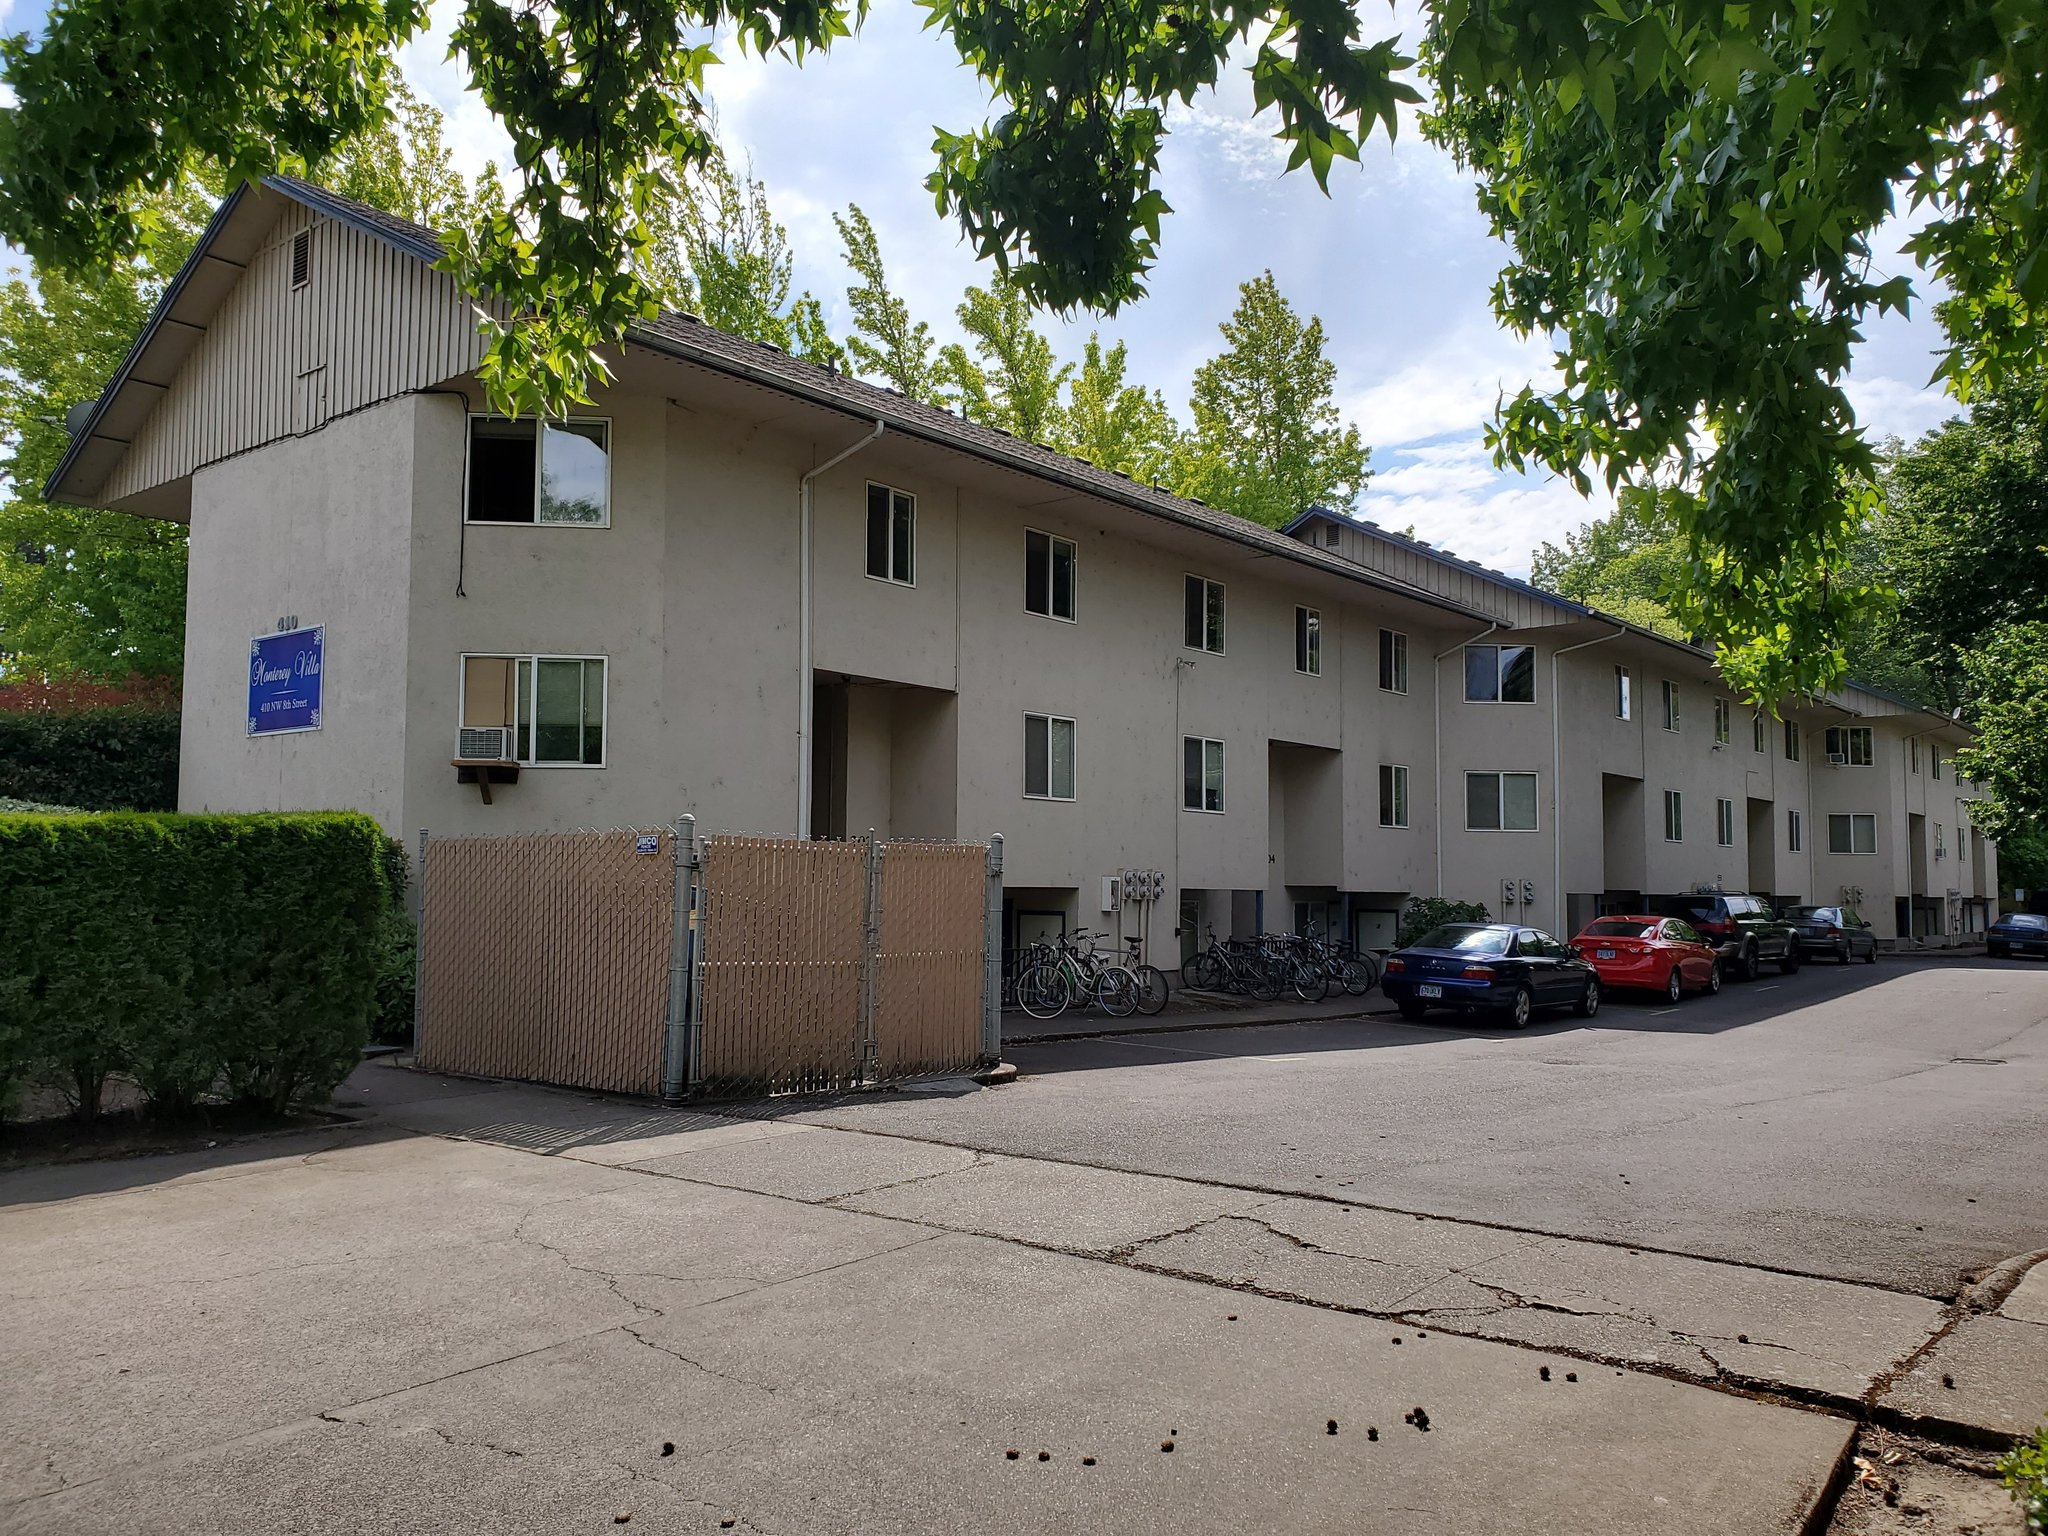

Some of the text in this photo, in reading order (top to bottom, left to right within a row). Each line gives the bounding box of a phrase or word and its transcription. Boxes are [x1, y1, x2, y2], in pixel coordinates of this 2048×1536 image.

[277, 615, 299, 632] 410
[250, 650, 320, 687] Monterey Villa
[260, 698, 308, 713] 410 NW 8th Street
